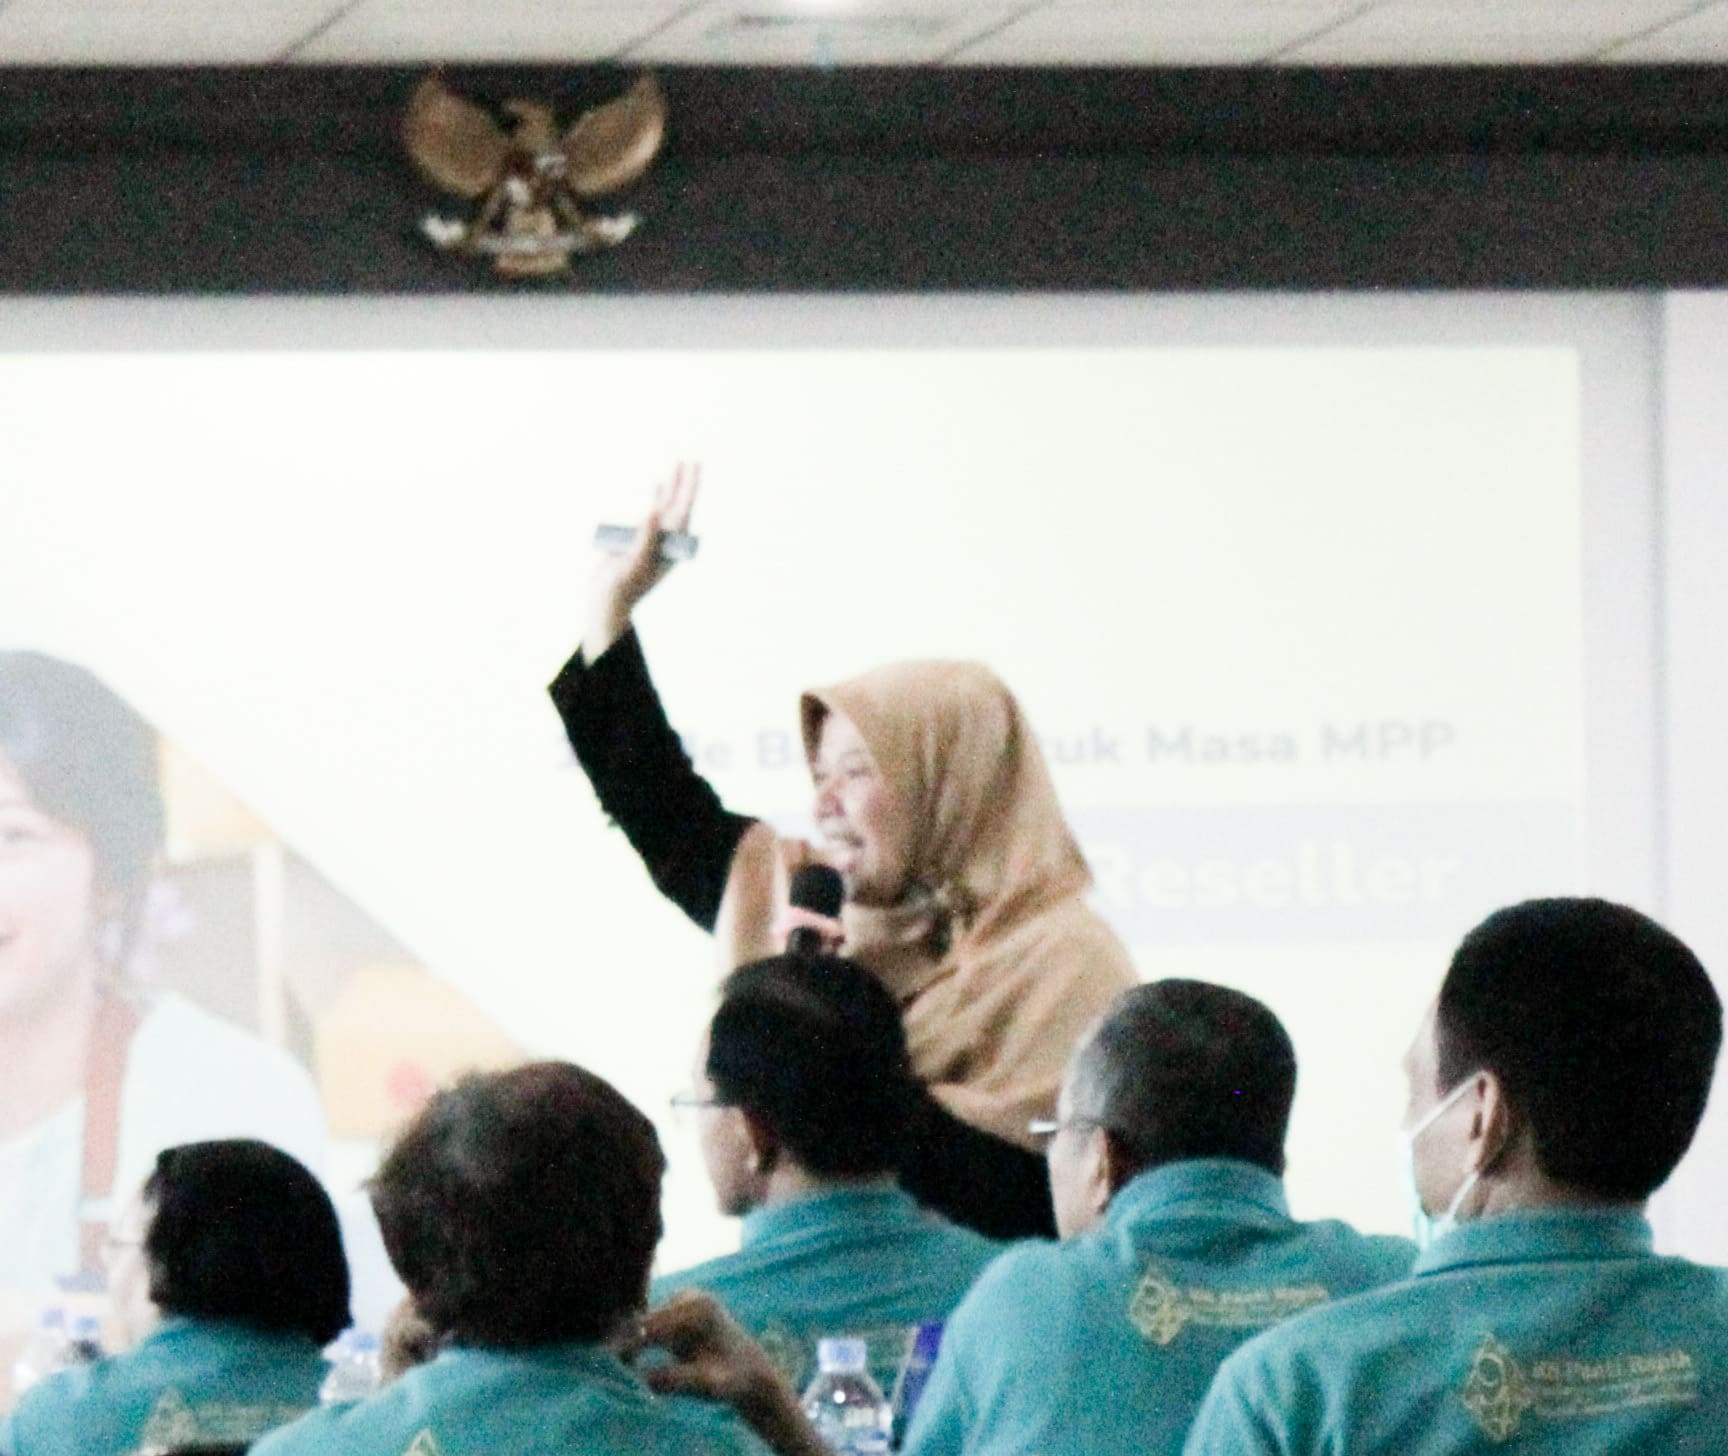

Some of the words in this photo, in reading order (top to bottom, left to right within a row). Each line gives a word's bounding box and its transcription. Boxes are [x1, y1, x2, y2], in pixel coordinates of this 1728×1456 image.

[1146, 723, 1299, 764] Masa
[1319, 718, 1456, 761] MPP
[1084, 840, 1459, 910] Reseller
